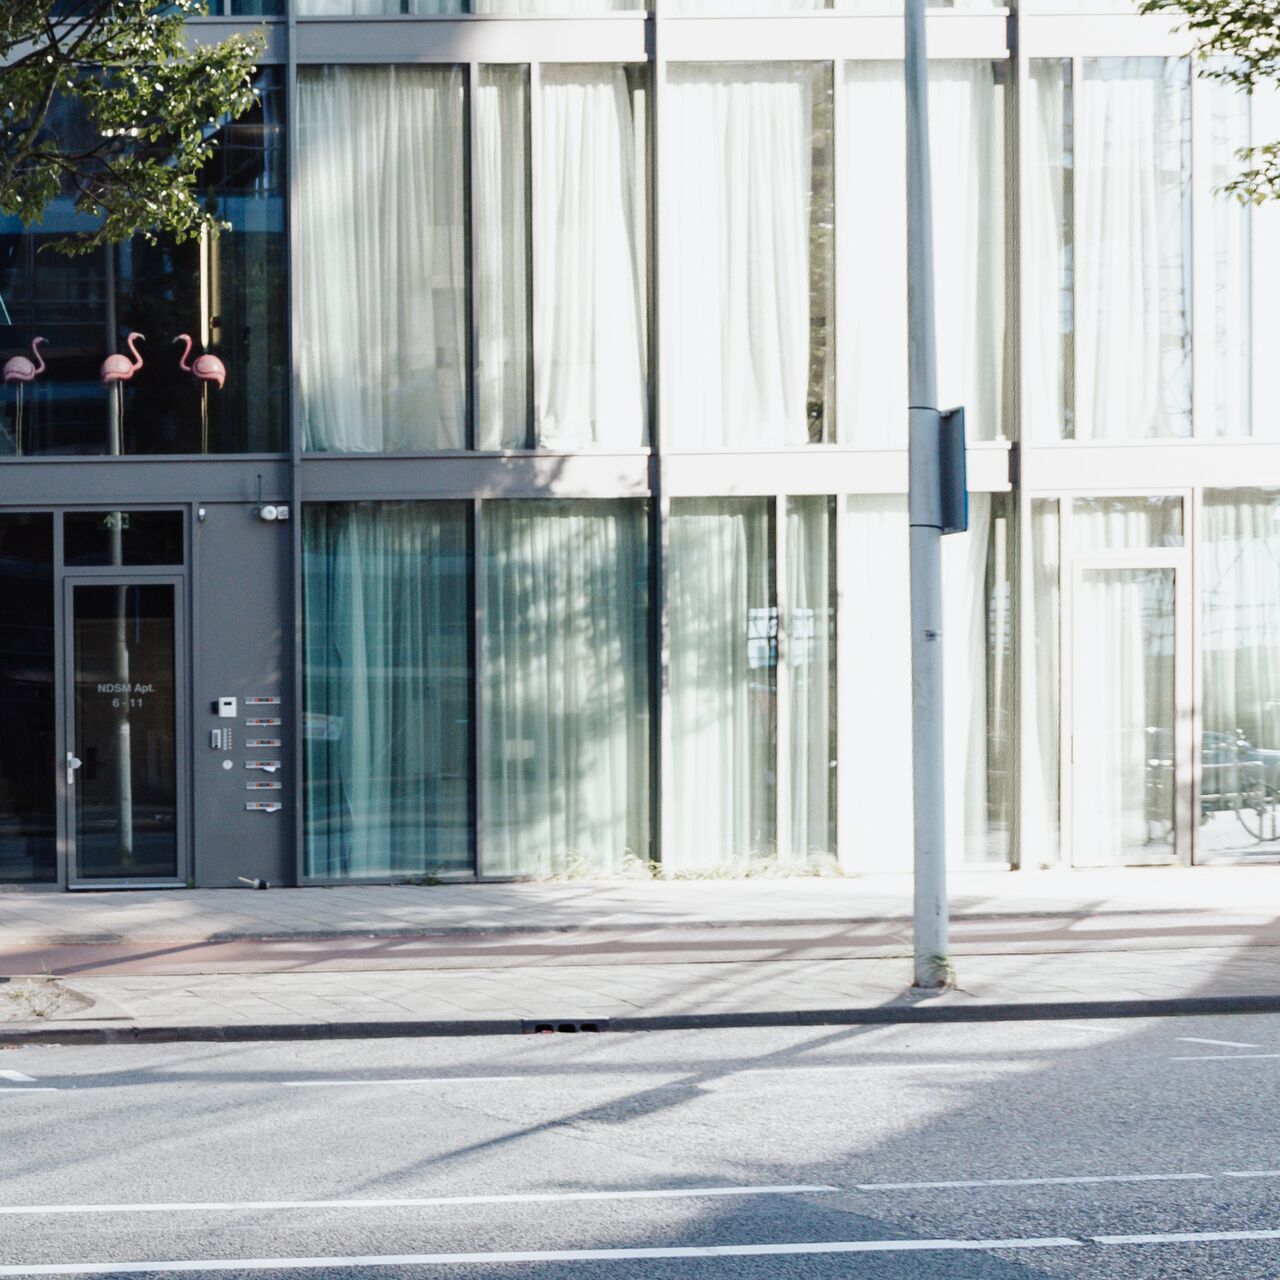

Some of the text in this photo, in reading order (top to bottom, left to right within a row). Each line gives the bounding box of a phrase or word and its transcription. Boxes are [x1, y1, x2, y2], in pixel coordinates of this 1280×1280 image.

[97, 683, 131, 693] NDSM
[112, 698, 120, 708] 6
[130, 698, 143, 708] 11
